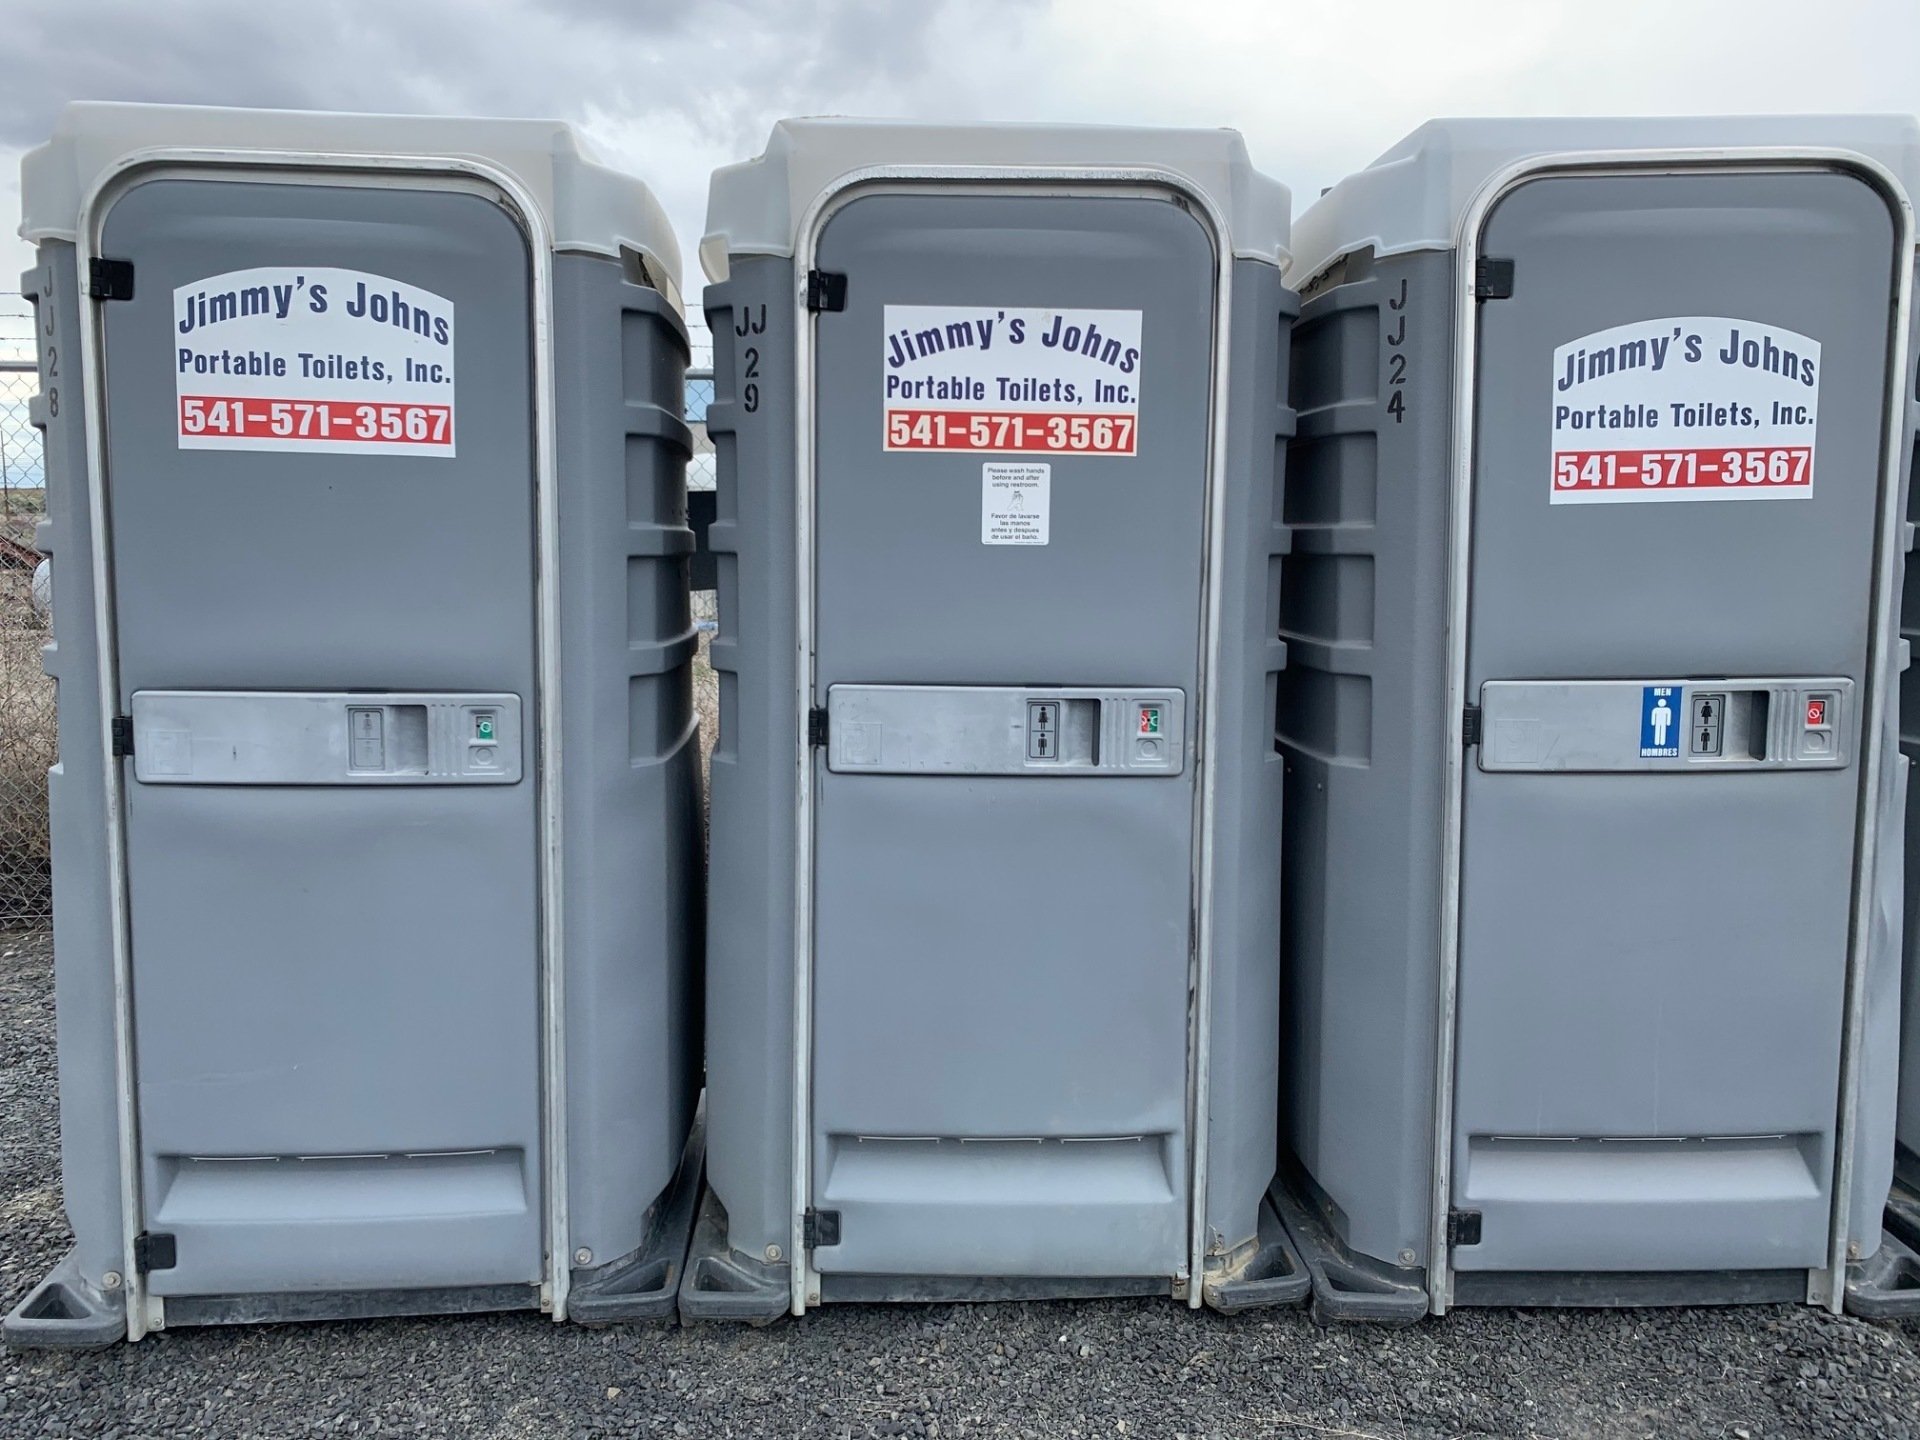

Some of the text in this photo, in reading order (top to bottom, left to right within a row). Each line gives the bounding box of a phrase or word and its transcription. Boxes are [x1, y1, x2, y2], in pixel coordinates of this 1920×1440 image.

[178, 275, 449, 346] Jimmy's Johns
[887, 310, 1139, 374] Jimmy's Johns
[1557, 326, 1815, 392] Jimmy's Johns
[178, 347, 451, 385] Portable Toilets, Inc.
[886, 374, 1136, 406] Portable Toilets, Inc.
[183, 399, 449, 441] 541-571-3567
[890, 413, 1133, 450] 541-571-3567
[1556, 400, 1814, 430] Portable Toilets, Inc.
[1556, 450, 1809, 487] 541-571-3567
[1653, 687, 1672, 696] MEN
[1641, 748, 1678, 757] HOMBRES
